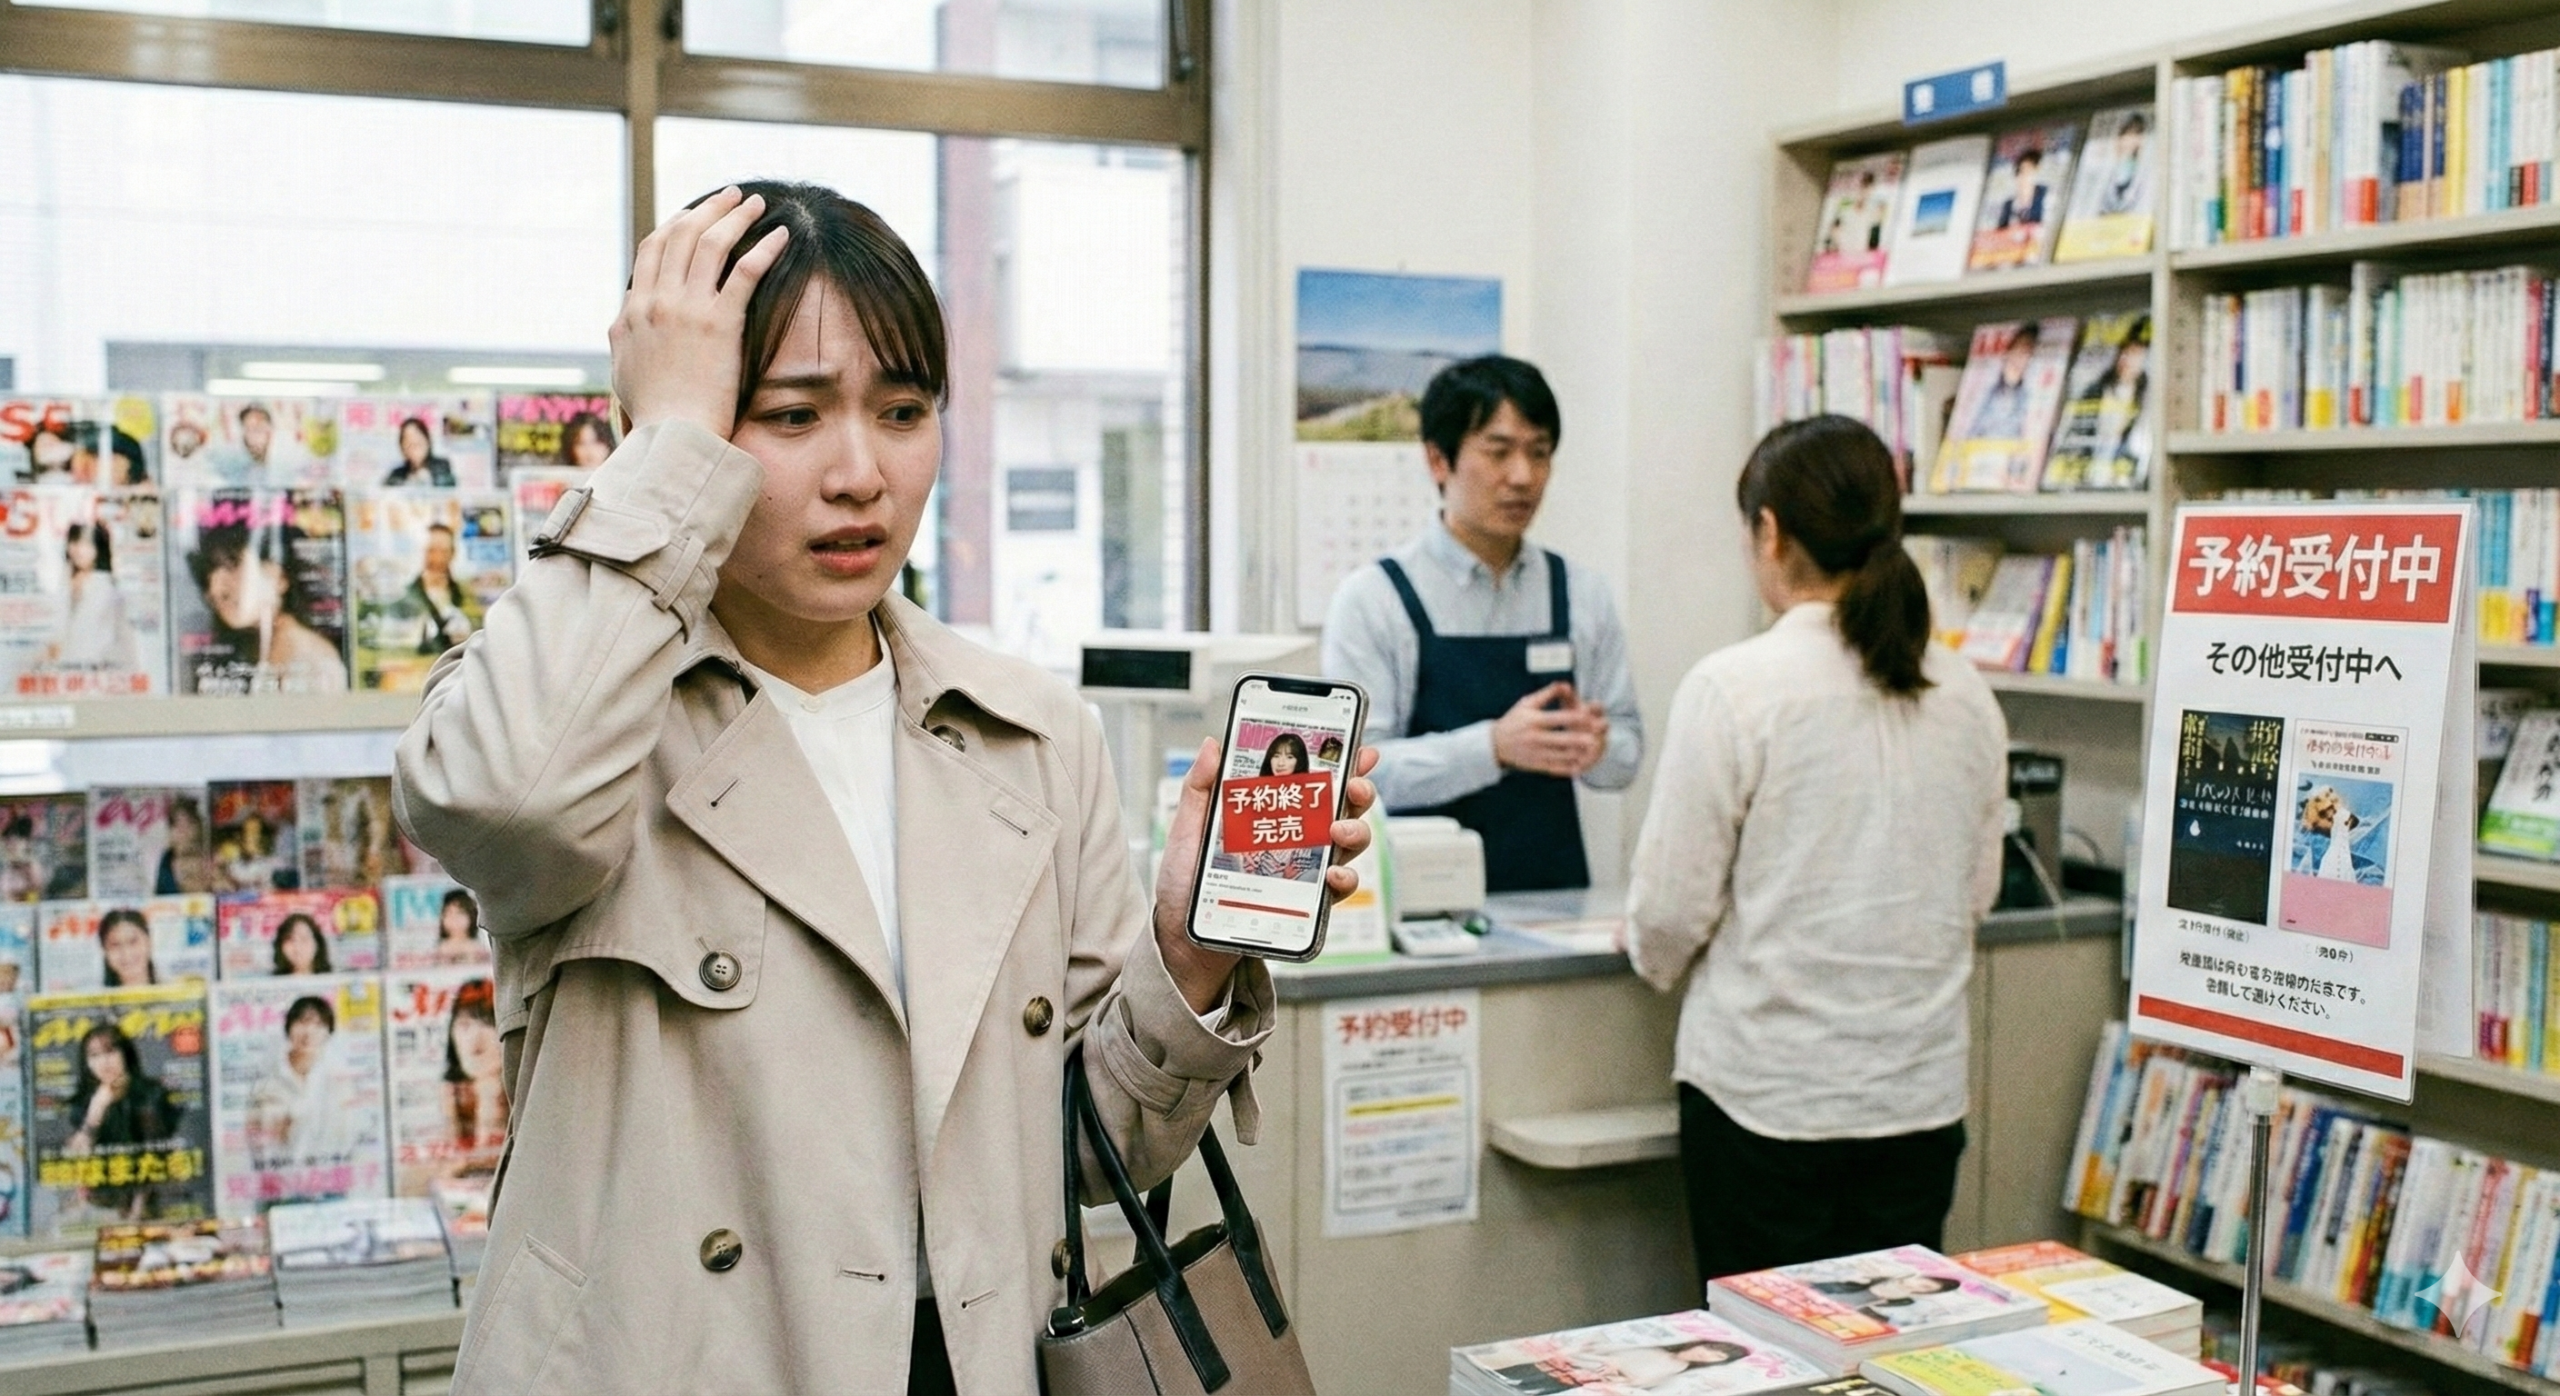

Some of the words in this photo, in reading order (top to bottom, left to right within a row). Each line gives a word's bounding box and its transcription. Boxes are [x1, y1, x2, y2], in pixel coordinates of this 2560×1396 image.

[2188, 534, 2441, 603] 予約受付中
[2205, 641, 2404, 684] その他受付中へ
[1227, 782, 1328, 815] 予約終了
[1252, 815, 1304, 845] 完売
[1336, 1008, 1469, 1045] 予約受付中
